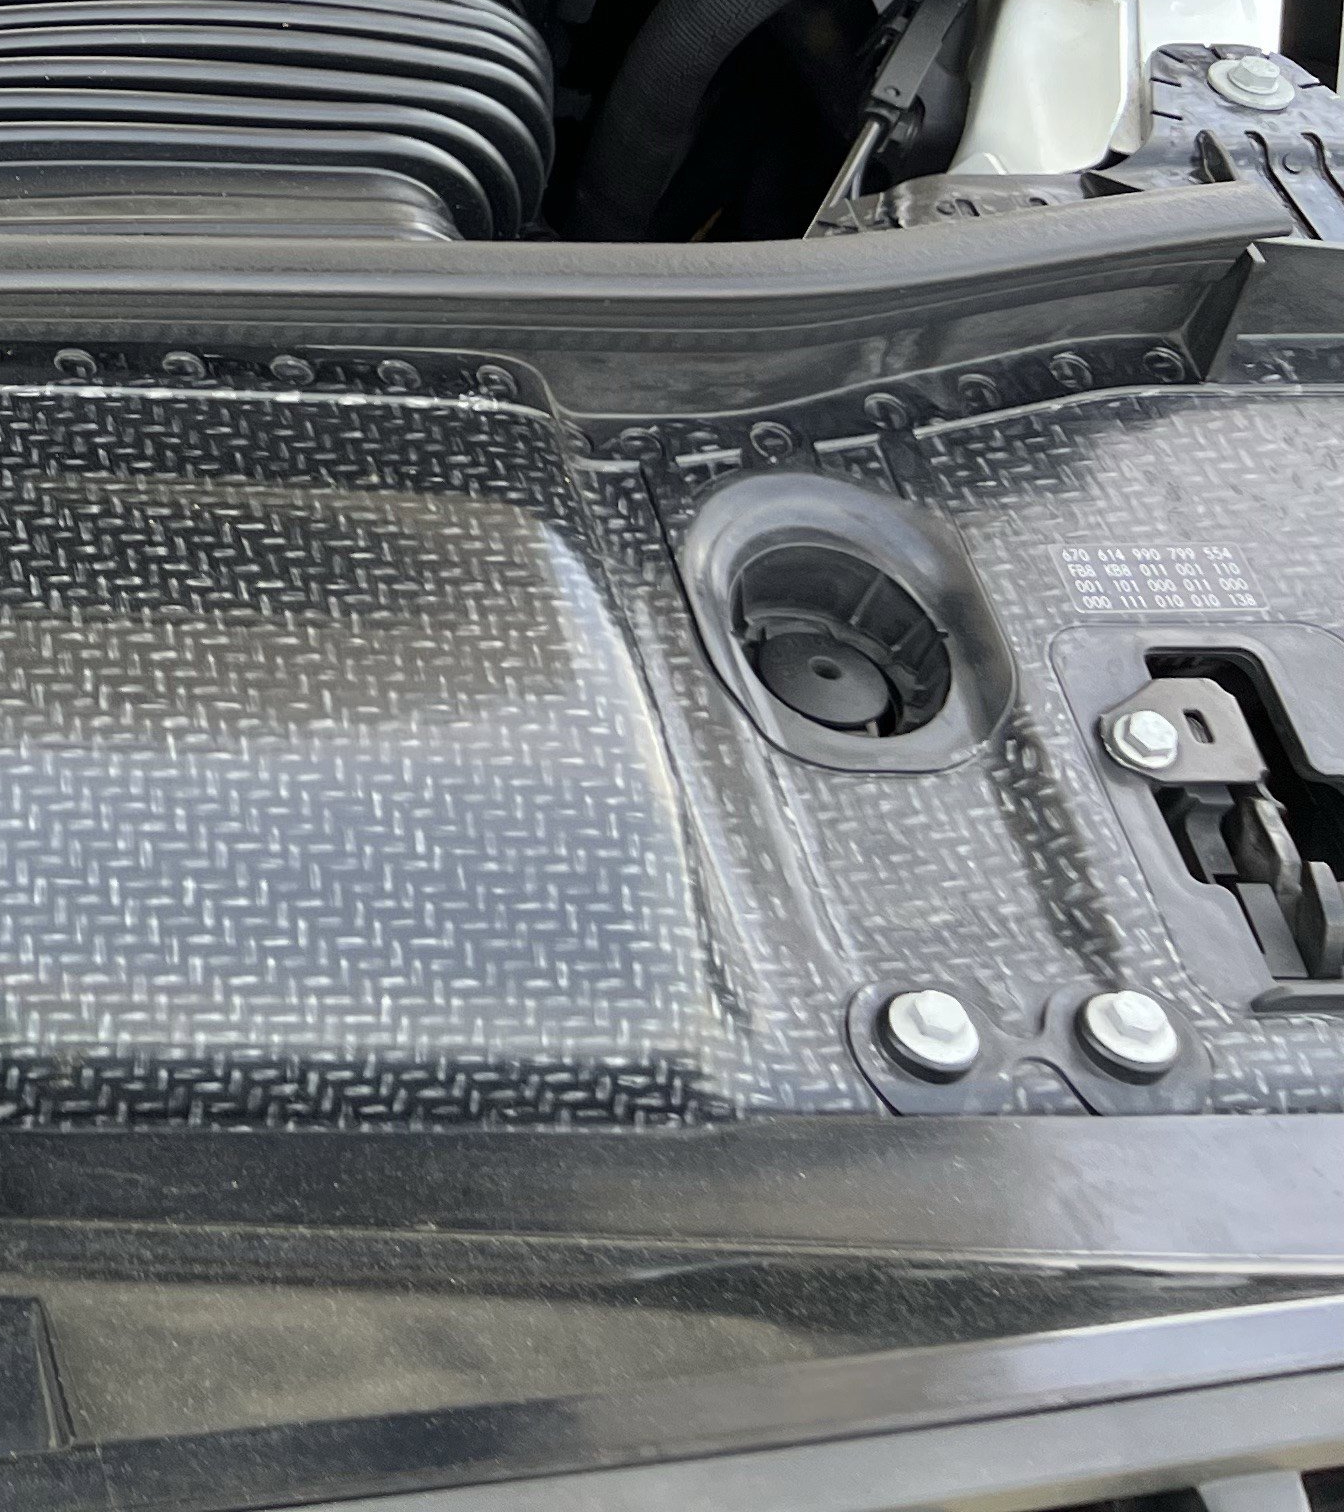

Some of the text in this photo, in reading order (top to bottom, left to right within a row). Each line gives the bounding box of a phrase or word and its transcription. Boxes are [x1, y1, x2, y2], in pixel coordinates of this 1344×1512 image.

[1062, 547, 1232, 561] 670 614 990 799 554
[1139, 564, 1168, 576] 011
[1175, 564, 1204, 575] 001
[1213, 563, 1241, 575] 110
[1075, 578, 1248, 593] 001 101 000 011 000
[1083, 594, 1256, 608] 000 111 010 010 138
